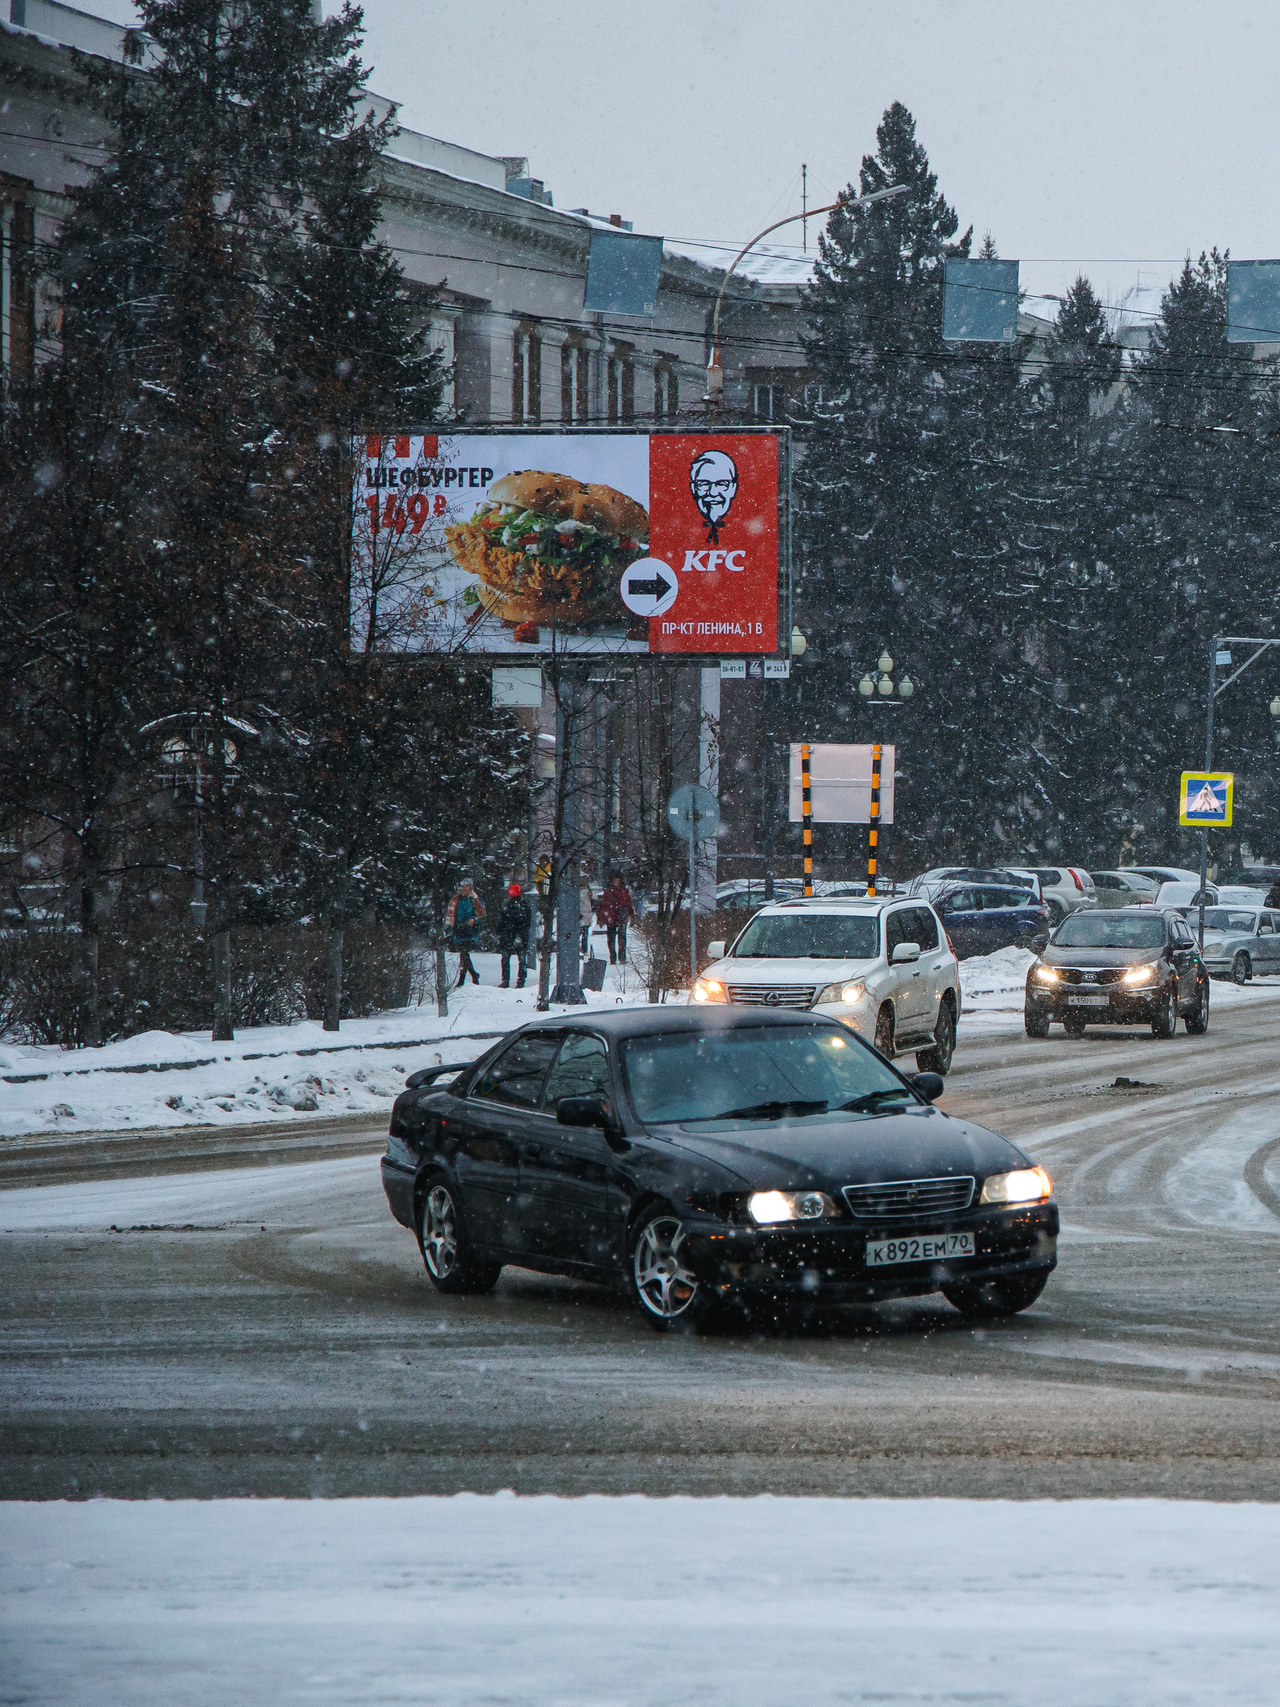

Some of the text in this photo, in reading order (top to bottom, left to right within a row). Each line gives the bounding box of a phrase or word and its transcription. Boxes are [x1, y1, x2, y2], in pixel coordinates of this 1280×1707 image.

[366, 467, 494, 488] ШЕФБУРГЕР
[681, 550, 746, 572] KFC
[661, 622, 695, 635] ПР-КТ
[696, 622, 745, 638] ЛЕНИНА,
[747, 622, 753, 635] 1
[874, 1235, 969, 1262] К892ЕМ 70
